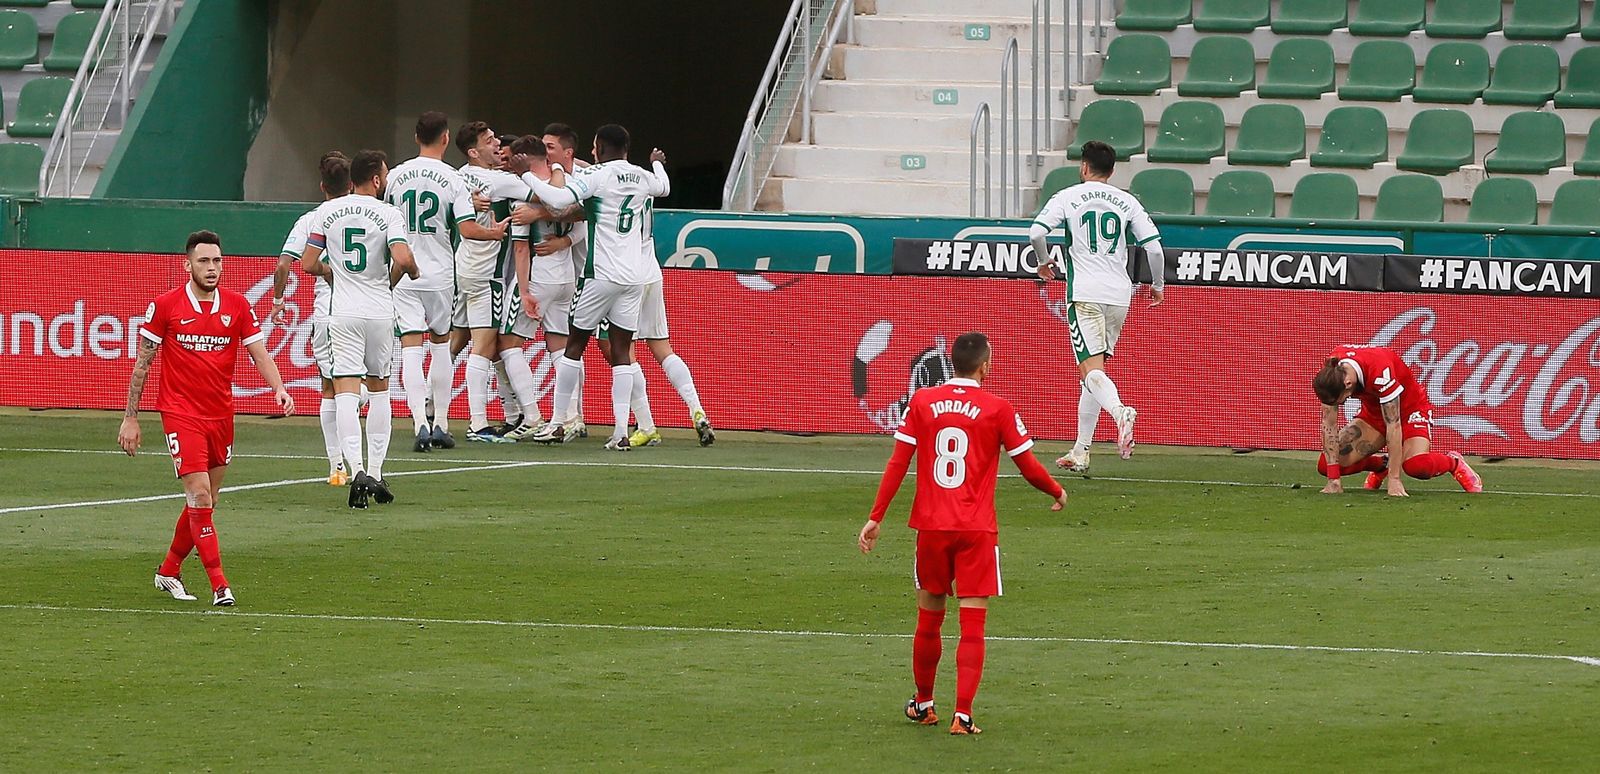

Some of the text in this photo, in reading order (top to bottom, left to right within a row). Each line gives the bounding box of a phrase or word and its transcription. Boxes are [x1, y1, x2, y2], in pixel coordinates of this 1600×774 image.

[969, 27, 985, 38] 05
[937, 92, 952, 102] 04
[397, 168, 449, 188] DANI CALVO
[906, 158, 921, 168] 03
[323, 206, 361, 230] GONZALO
[400, 189, 440, 234] 12
[616, 194, 635, 236] 6
[1080, 210, 1121, 256] 19
[341, 227, 367, 274] 5
[926, 240, 1067, 274] #FANCA
[1176, 250, 1348, 285] #FANCAM
[1419, 258, 1592, 293] #FANCAM
[0, 299, 147, 360] nder
[176, 333, 231, 344] MARATHON
[194, 343, 213, 352] BET
[929, 400, 981, 420] JORDÁN
[933, 426, 969, 489] 8
